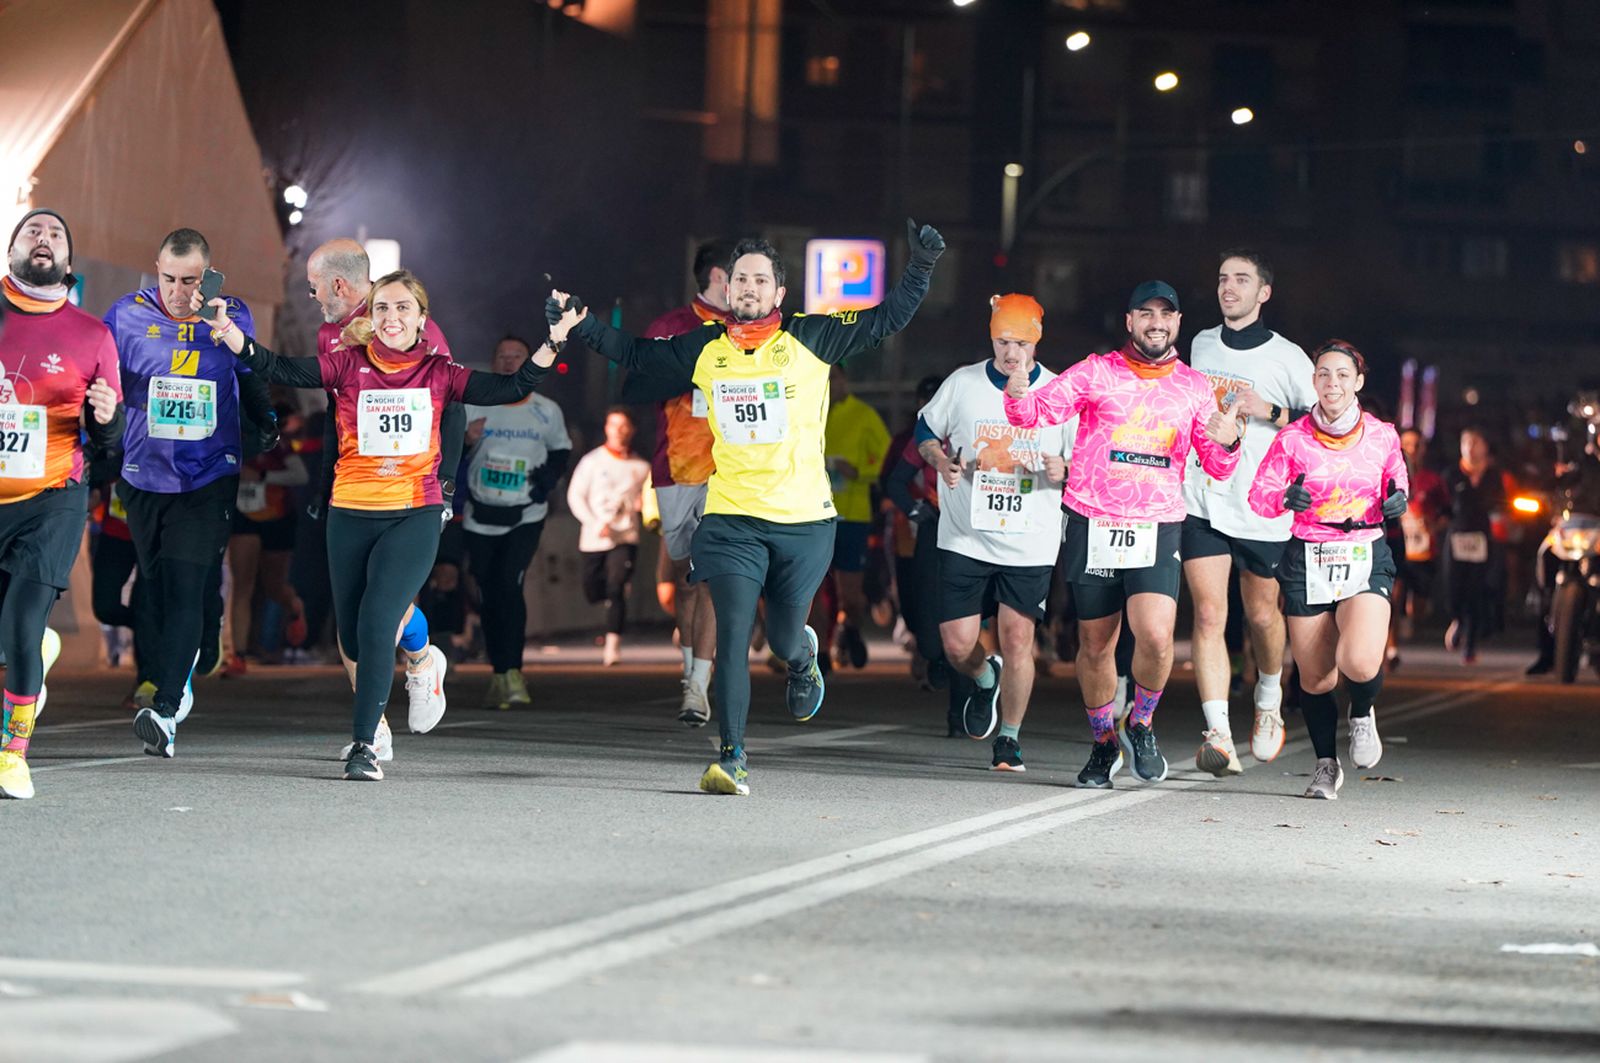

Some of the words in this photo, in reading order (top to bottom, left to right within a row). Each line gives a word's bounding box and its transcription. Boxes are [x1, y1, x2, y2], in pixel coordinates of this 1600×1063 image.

[822, 251, 869, 296] P
[178, 324, 195, 342] 21
[159, 400, 207, 420] 12154
[366, 405, 380, 413] SAN
[734, 402, 767, 423] 591
[379, 413, 412, 433] 319
[977, 423, 1037, 441] INSTANTE
[495, 428, 540, 441] aqualia
[1011, 448, 1039, 461] SUEO
[1126, 454, 1167, 467] CaixaBank
[487, 469, 519, 487] 13171
[987, 494, 1022, 512] 1313
[1096, 520, 1110, 528] SAN
[1109, 529, 1136, 547] 776
